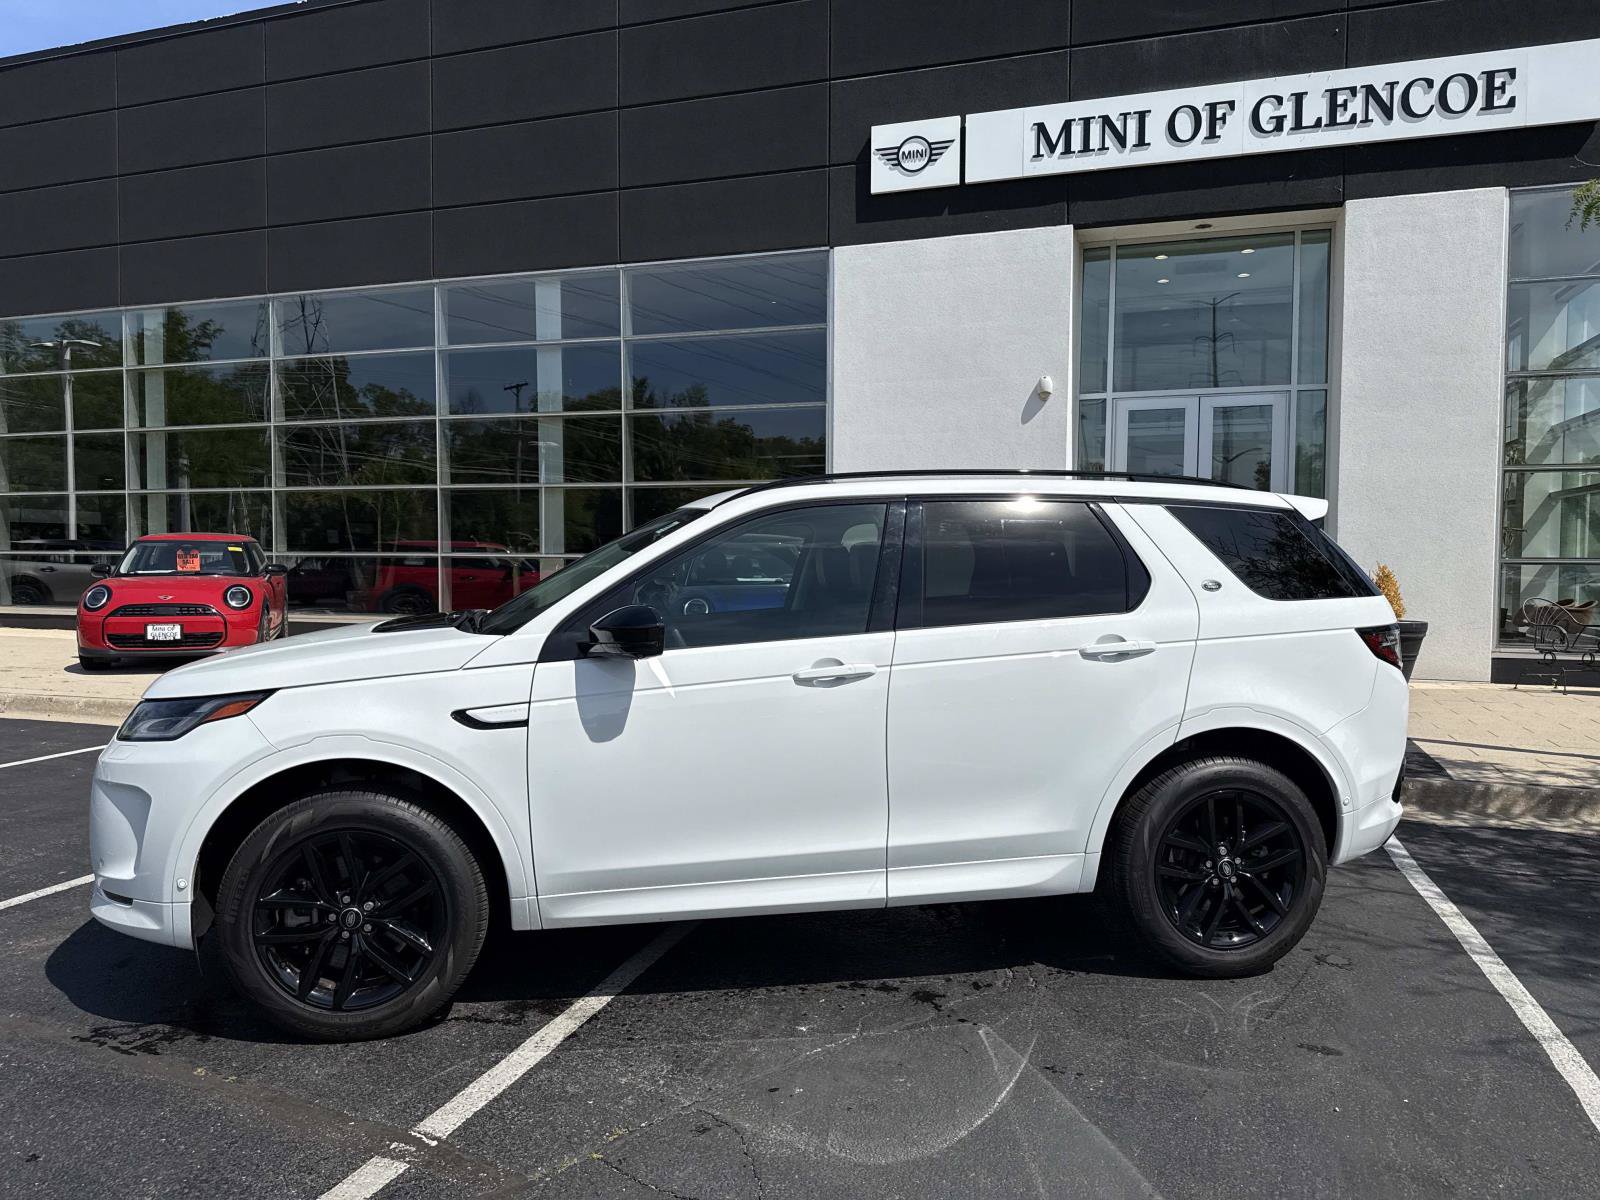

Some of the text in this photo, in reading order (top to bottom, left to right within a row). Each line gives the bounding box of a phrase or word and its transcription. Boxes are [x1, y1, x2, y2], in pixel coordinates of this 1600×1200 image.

[1032, 67, 1517, 159] MINI OF GLENCOE
[901, 148, 928, 161] MINI
